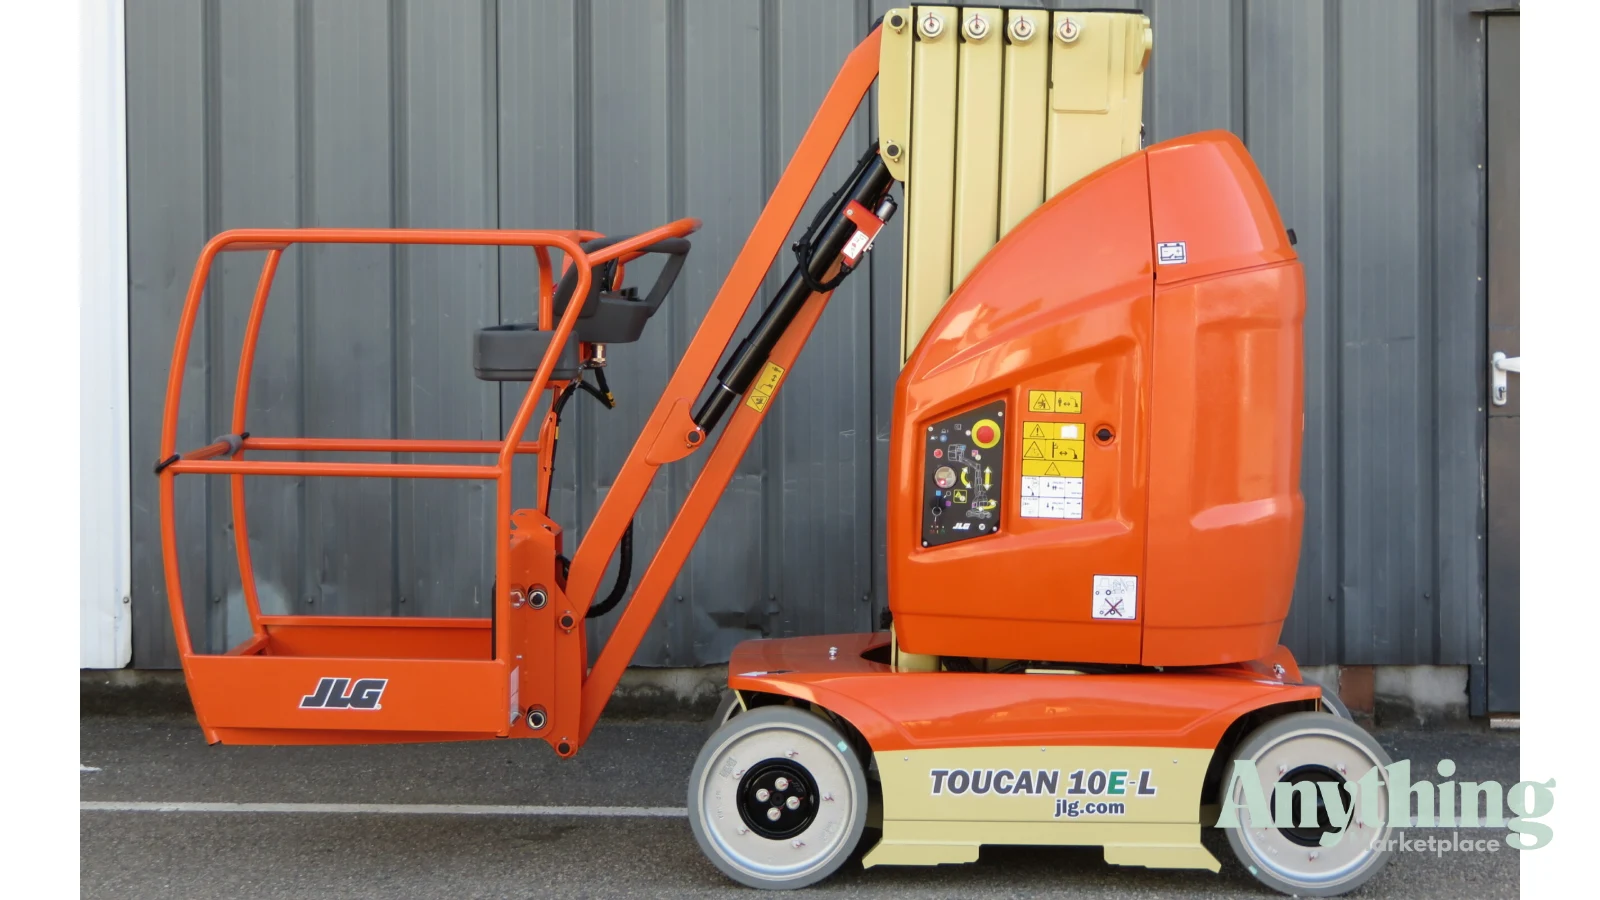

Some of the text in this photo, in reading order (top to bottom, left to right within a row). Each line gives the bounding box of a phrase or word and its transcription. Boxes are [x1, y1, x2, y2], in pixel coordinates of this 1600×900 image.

[953, 522, 971, 530] JLG
[299, 677, 388, 710] JLG
[930, 769, 1157, 797] TOUCAN 10E-L
[1055, 799, 1126, 818] jlg.com
